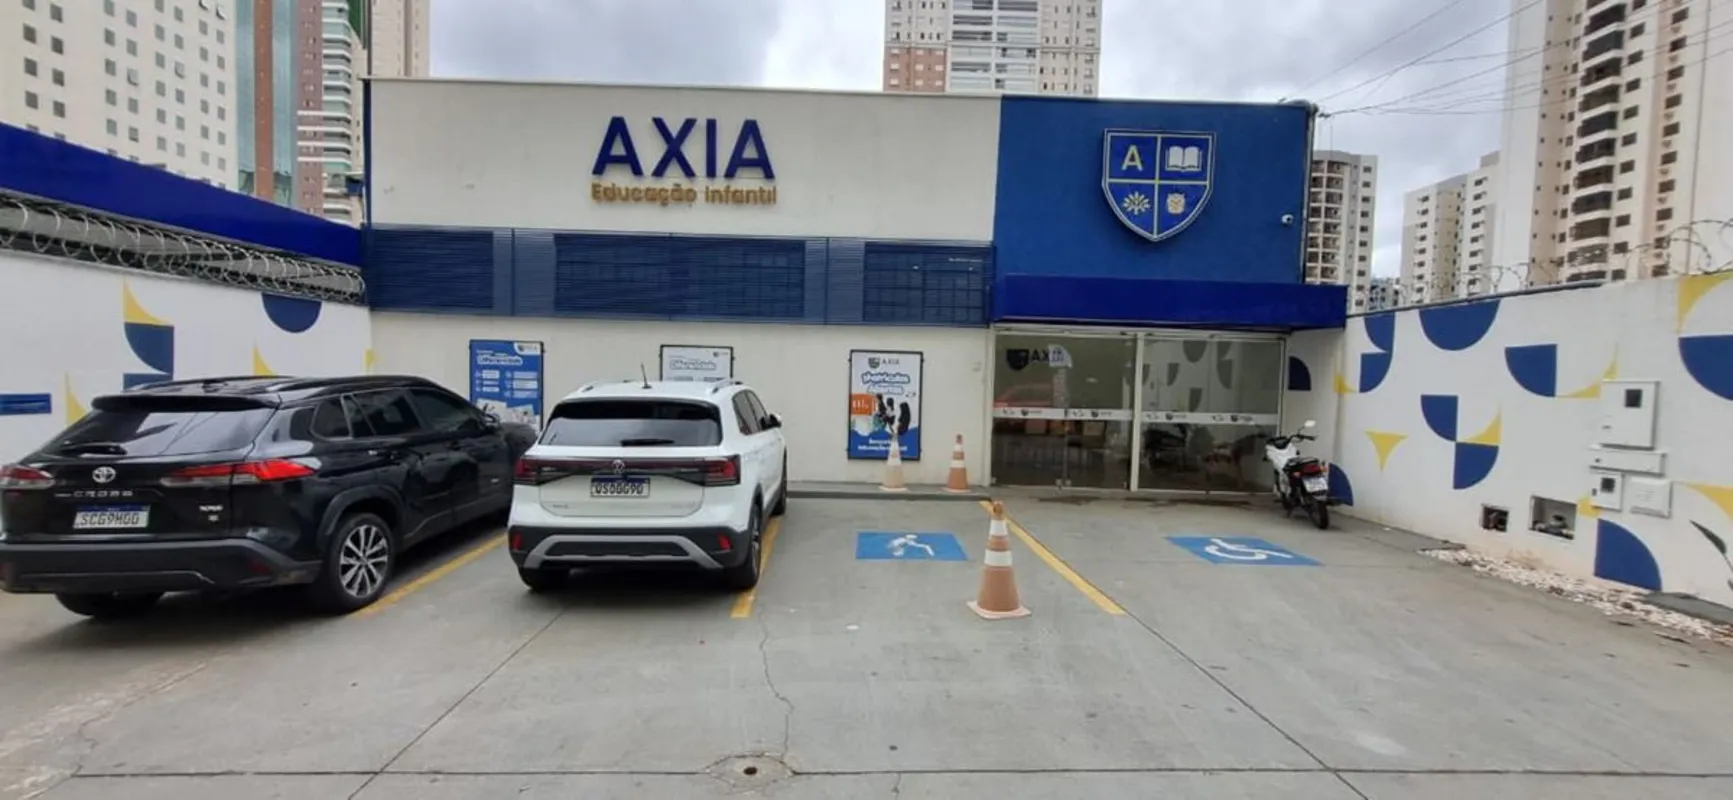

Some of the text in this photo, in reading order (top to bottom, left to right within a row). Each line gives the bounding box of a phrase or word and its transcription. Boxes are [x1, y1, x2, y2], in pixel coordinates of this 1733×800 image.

[591, 115, 776, 180] AXIA
[1121, 144, 1143, 171] A
[591, 182, 698, 206] Educação
